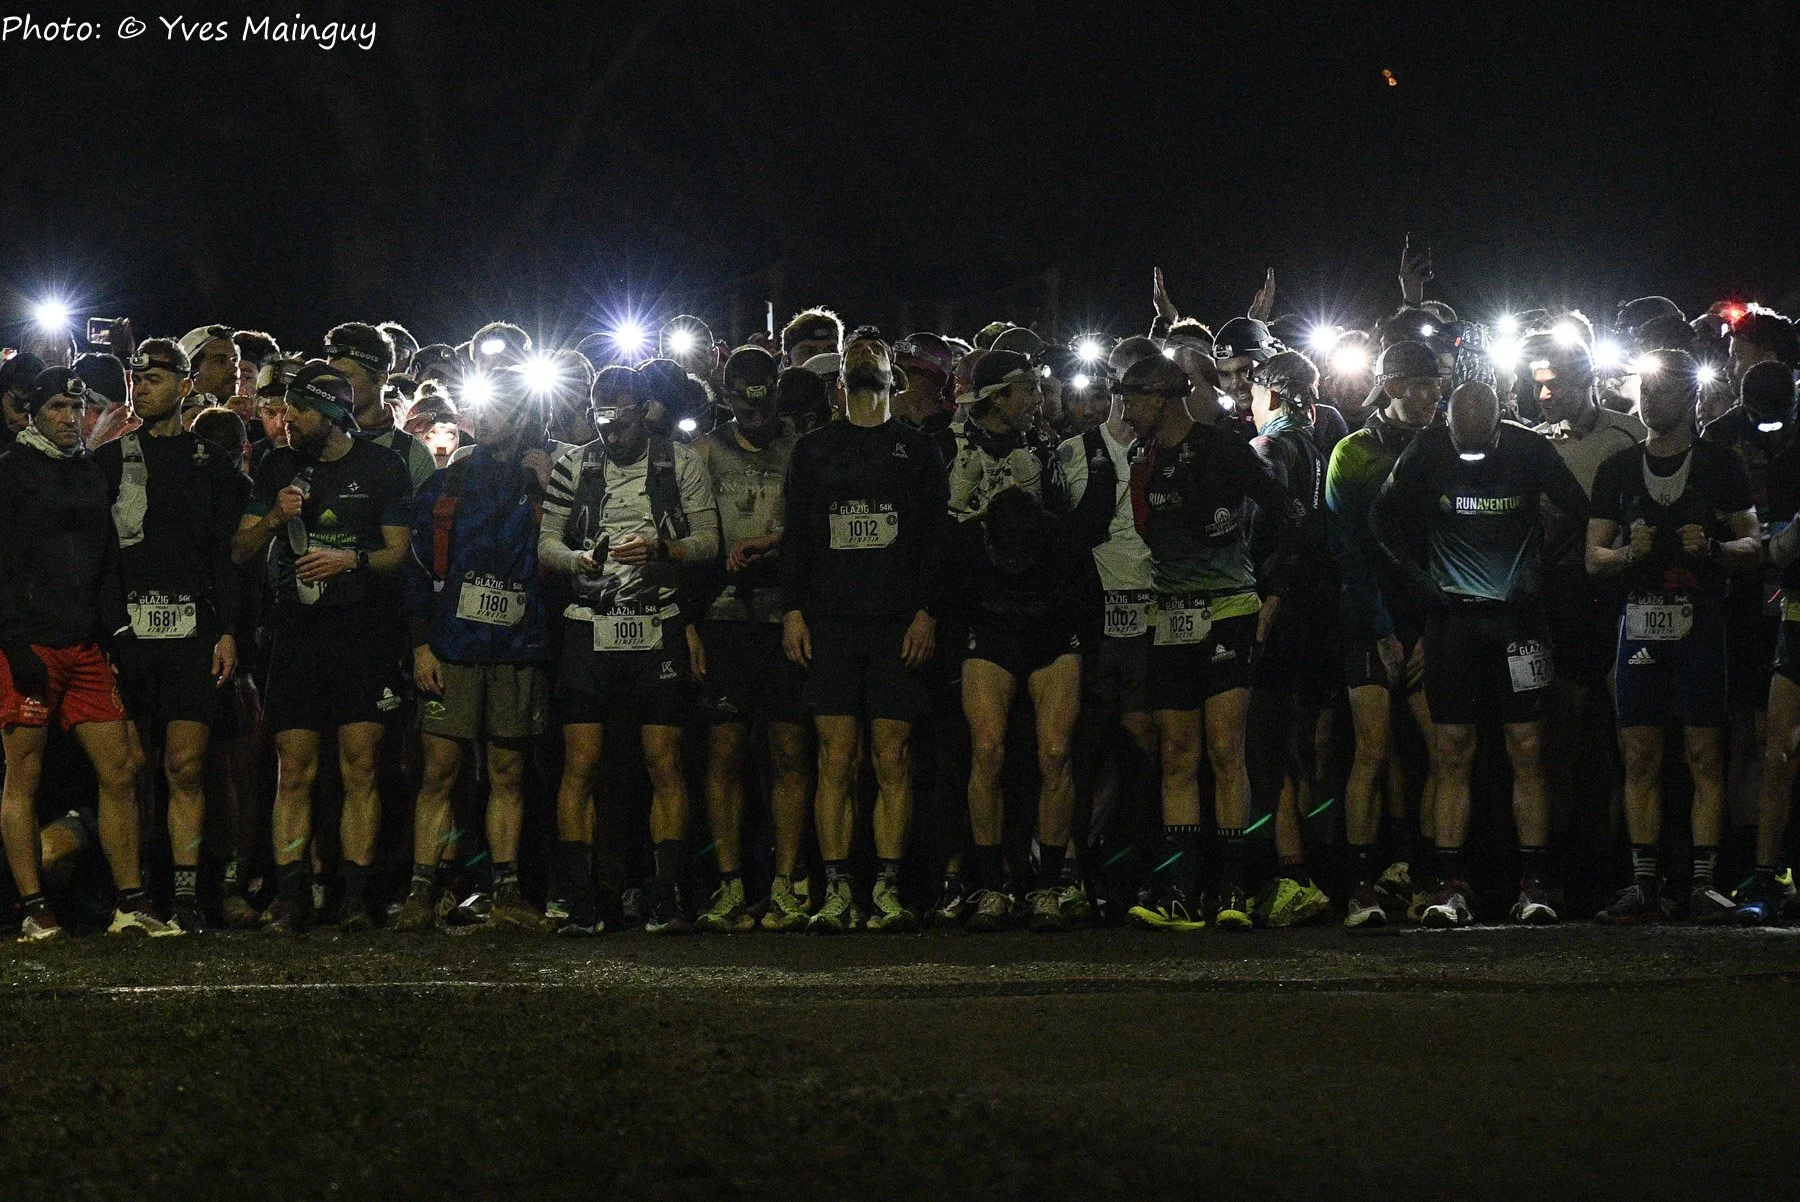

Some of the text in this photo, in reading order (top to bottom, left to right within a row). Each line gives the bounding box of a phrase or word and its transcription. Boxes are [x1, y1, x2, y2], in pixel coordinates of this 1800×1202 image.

[840, 503, 894, 515] GLAZIG 54K
[848, 520, 878, 537] 1012
[475, 576, 505, 590] GLAZIG
[178, 594, 192, 603] 54K
[480, 592, 508, 613] 1180
[147, 610, 176, 627] 1681
[1106, 610, 1138, 627] 1002
[1169, 614, 1194, 633] 1025
[1644, 611, 1673, 628] 1021
[613, 620, 643, 639] 1001
